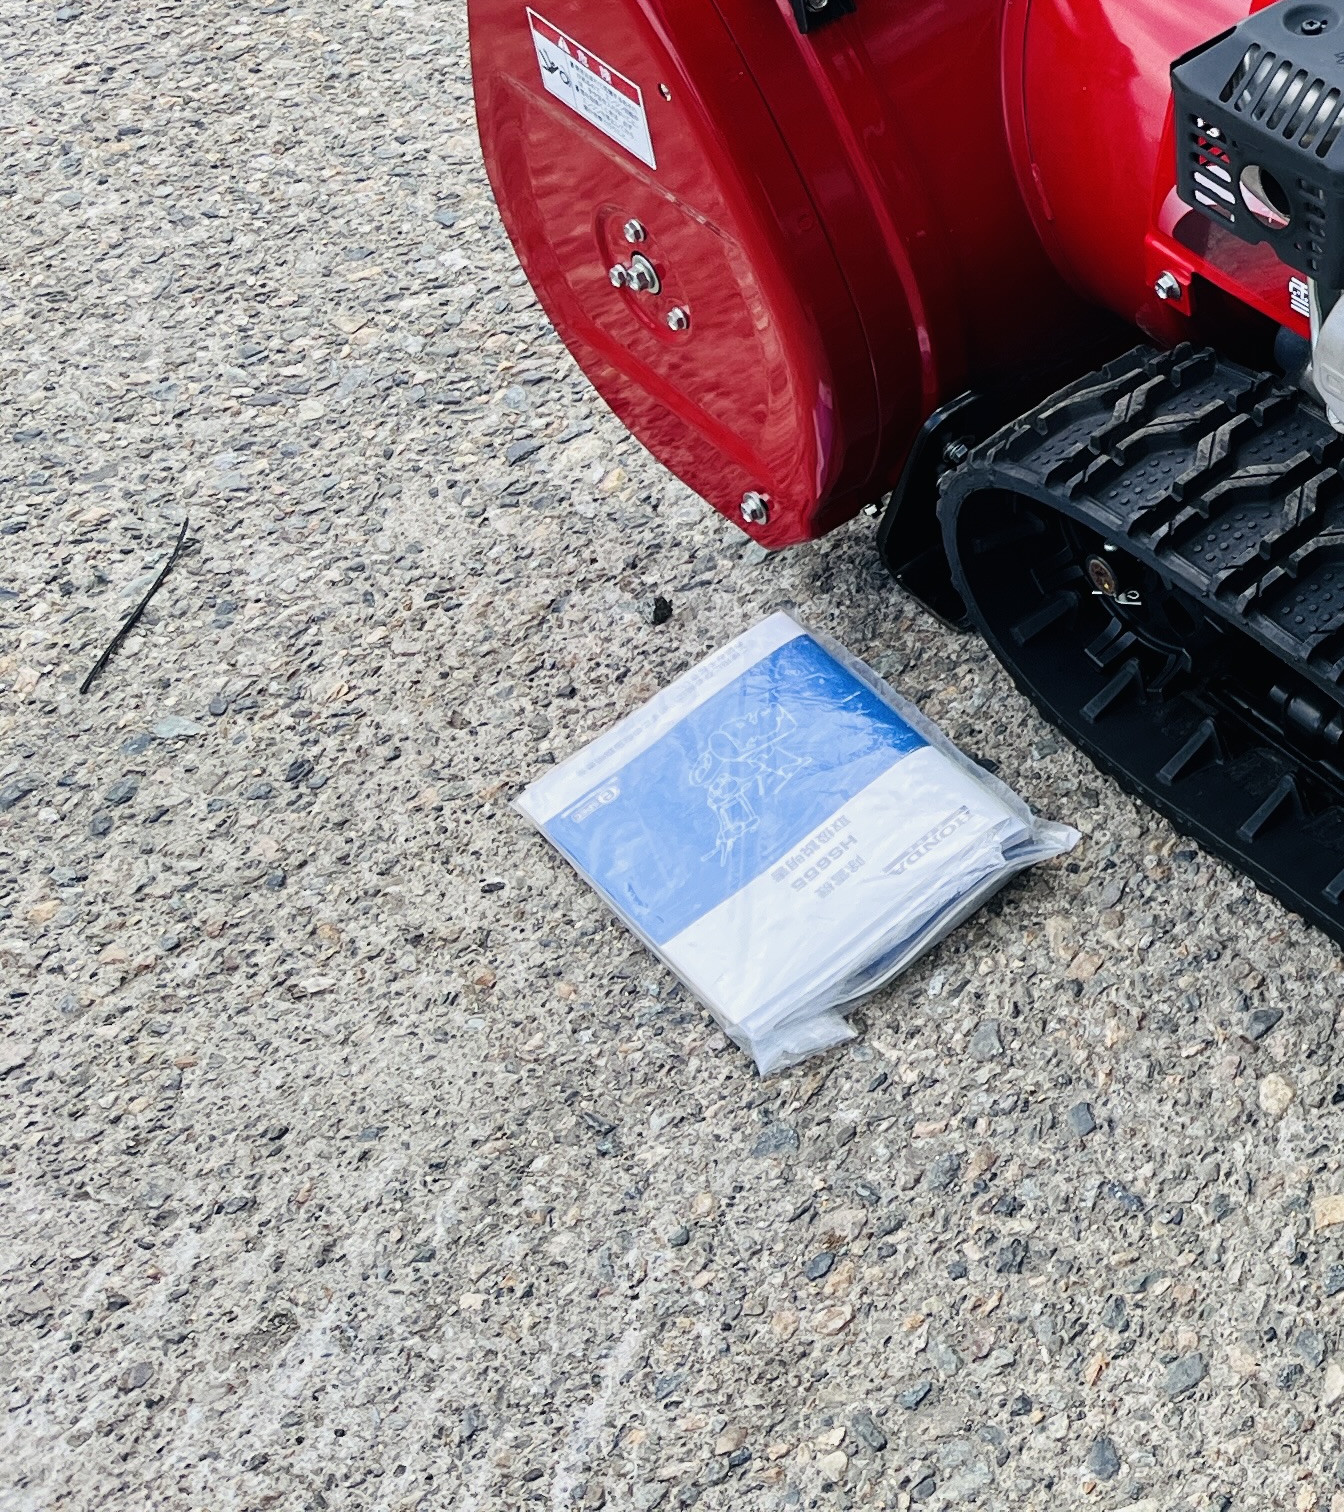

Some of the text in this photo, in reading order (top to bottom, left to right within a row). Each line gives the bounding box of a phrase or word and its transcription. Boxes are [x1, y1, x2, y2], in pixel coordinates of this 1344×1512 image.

[771, 814, 851, 883] 取扱説明書
[791, 834, 858, 892] HS655
[889, 810, 974, 875] HONDA
[814, 854, 866, 899] 除雪機
